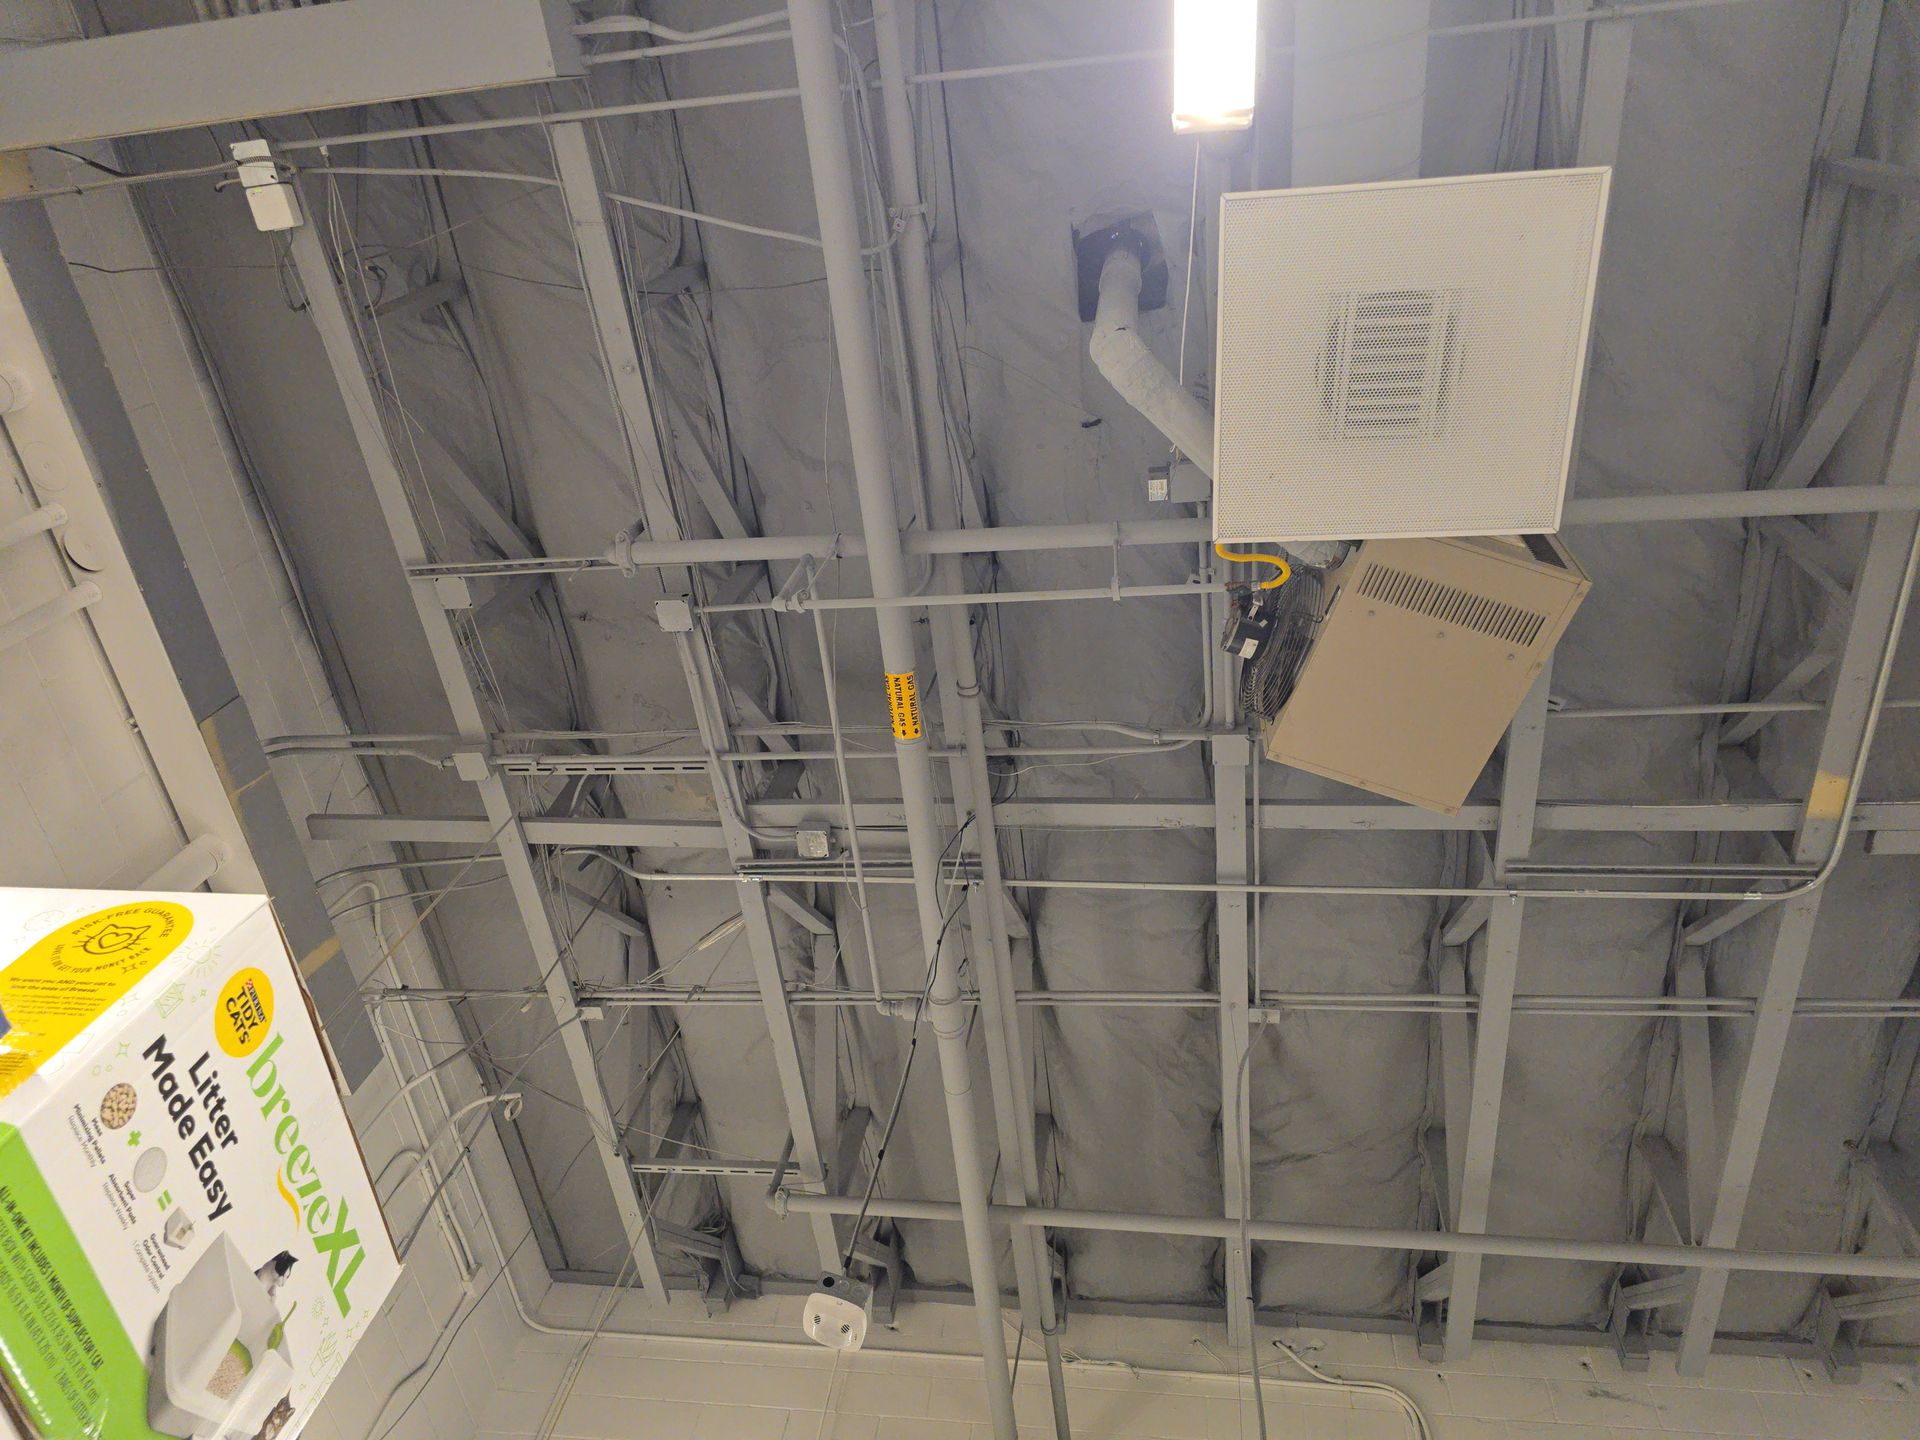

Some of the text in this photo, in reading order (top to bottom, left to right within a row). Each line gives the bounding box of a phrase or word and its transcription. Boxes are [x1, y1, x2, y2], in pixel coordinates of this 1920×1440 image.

[894, 677, 906, 727] NATURAL GAS
[907, 675, 919, 726] NATURAL GAS
[71, 907, 175, 938] RISK-FREE GUARANTEE
[94, 959, 126, 972] MONEY
[128, 947, 153, 960] BACK
[227, 998, 248, 1044] CATS
[237, 987, 257, 1029] TIDY
[247, 984, 266, 1024] PURINA
[189, 1052, 237, 1148] Litter
[143, 1035, 232, 1221] Made Easy
[123, 1179, 137, 1203] Super
[142, 1238, 164, 1280] Odor Control
[26, 1238, 51, 1276] INCLUDES
[47, 1274, 67, 1303] MONTH
[65, 1308, 88, 1343] SUPPLIES
[81, 1336, 94, 1354] FOR
[90, 1353, 103, 1370] CAT
